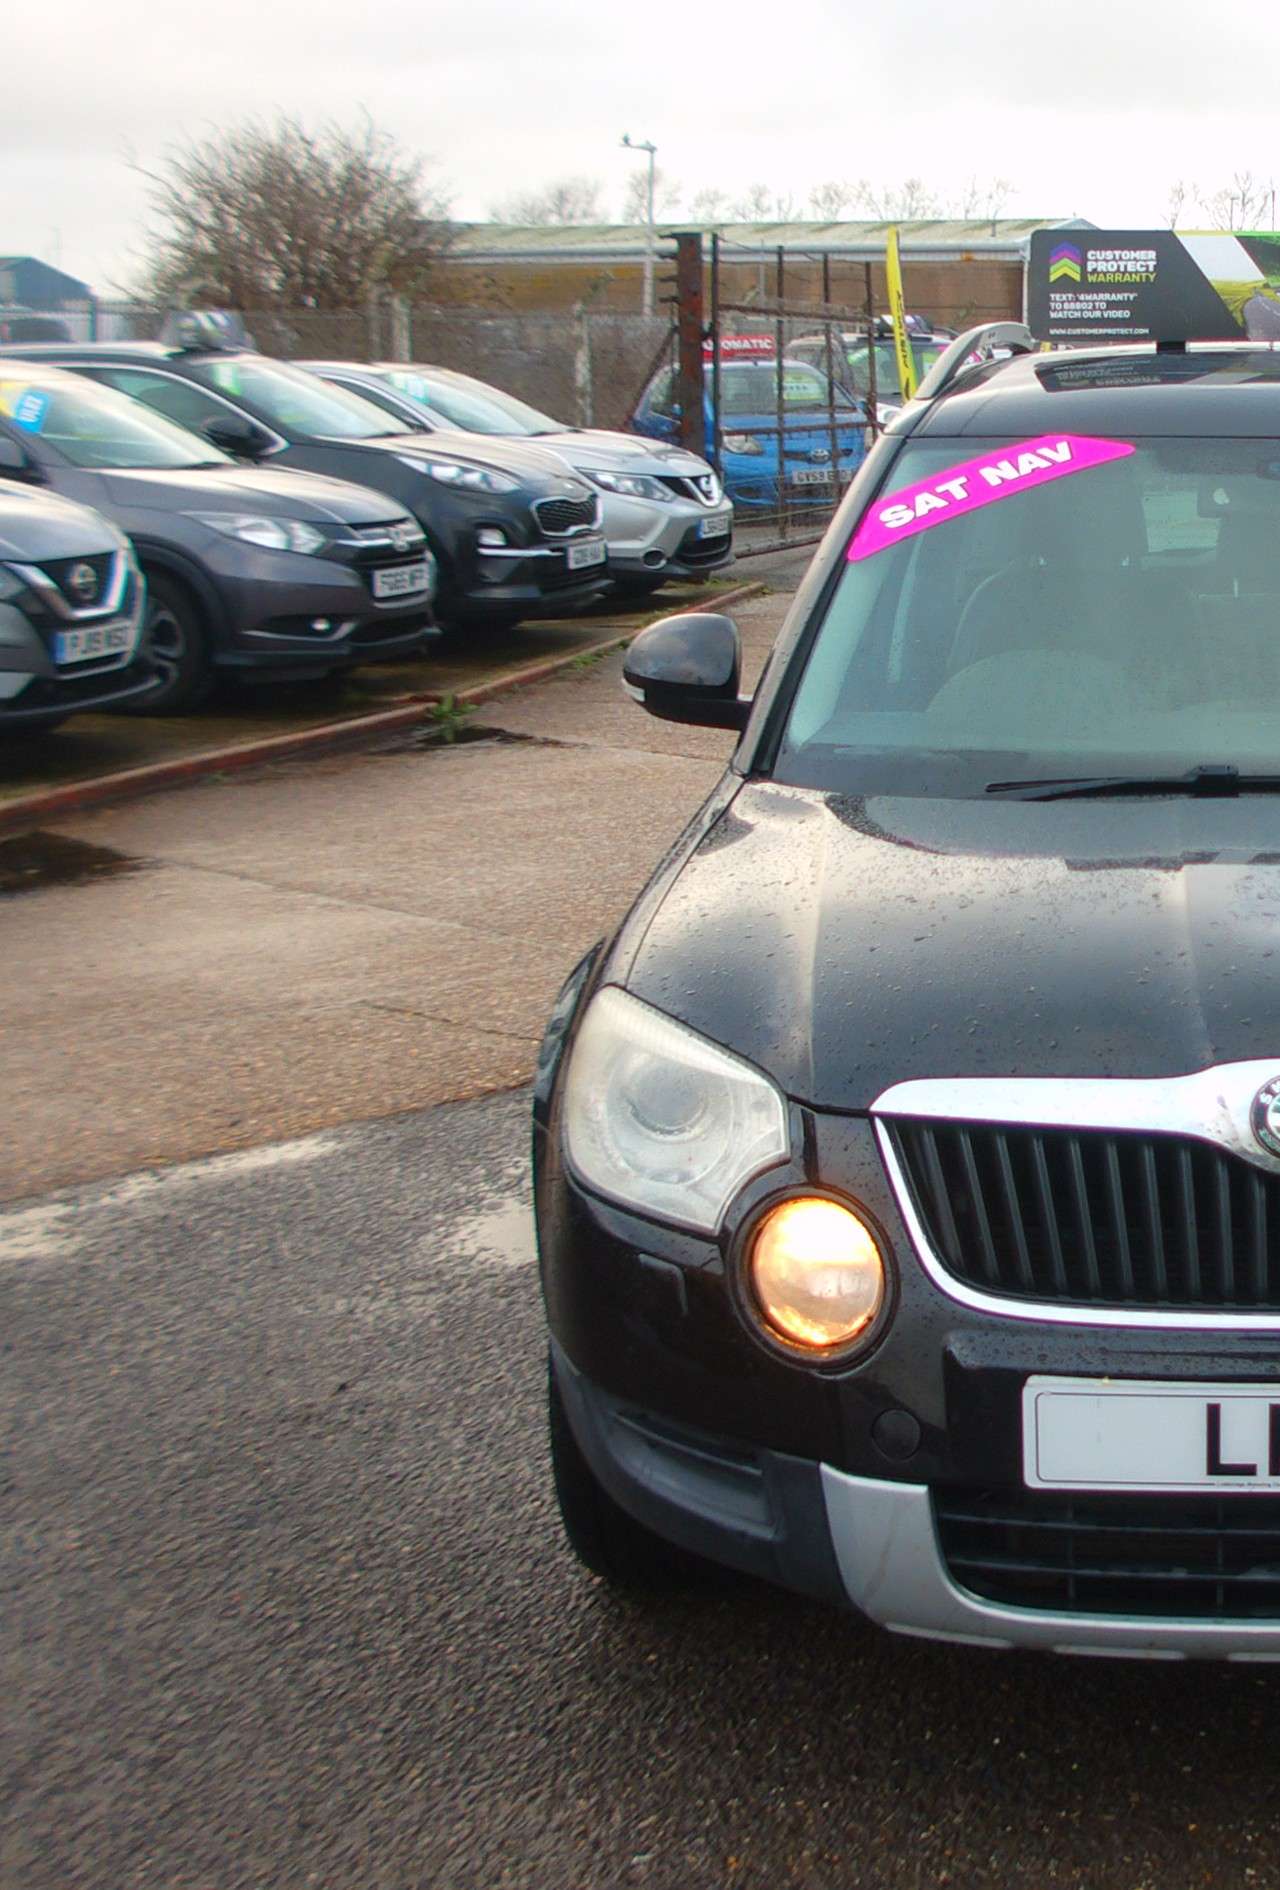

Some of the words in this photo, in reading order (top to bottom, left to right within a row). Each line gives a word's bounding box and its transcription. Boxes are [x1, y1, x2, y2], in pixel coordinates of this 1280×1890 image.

[1087, 250, 1157, 260] CUSTOMER
[1087, 261, 1157, 272] PROTECT
[1087, 272, 1157, 283] WARRANTY
[1049, 293, 1076, 301] TEXT:
[1049, 302, 1062, 310] TO
[1094, 302, 1107, 310] TO
[1049, 310, 1081, 319] WATCH
[1082, 310, 1102, 319] OUR
[1103, 310, 1131, 319] VIDEO
[878, 475, 969, 529] SAT
[978, 440, 1074, 487] NAV
